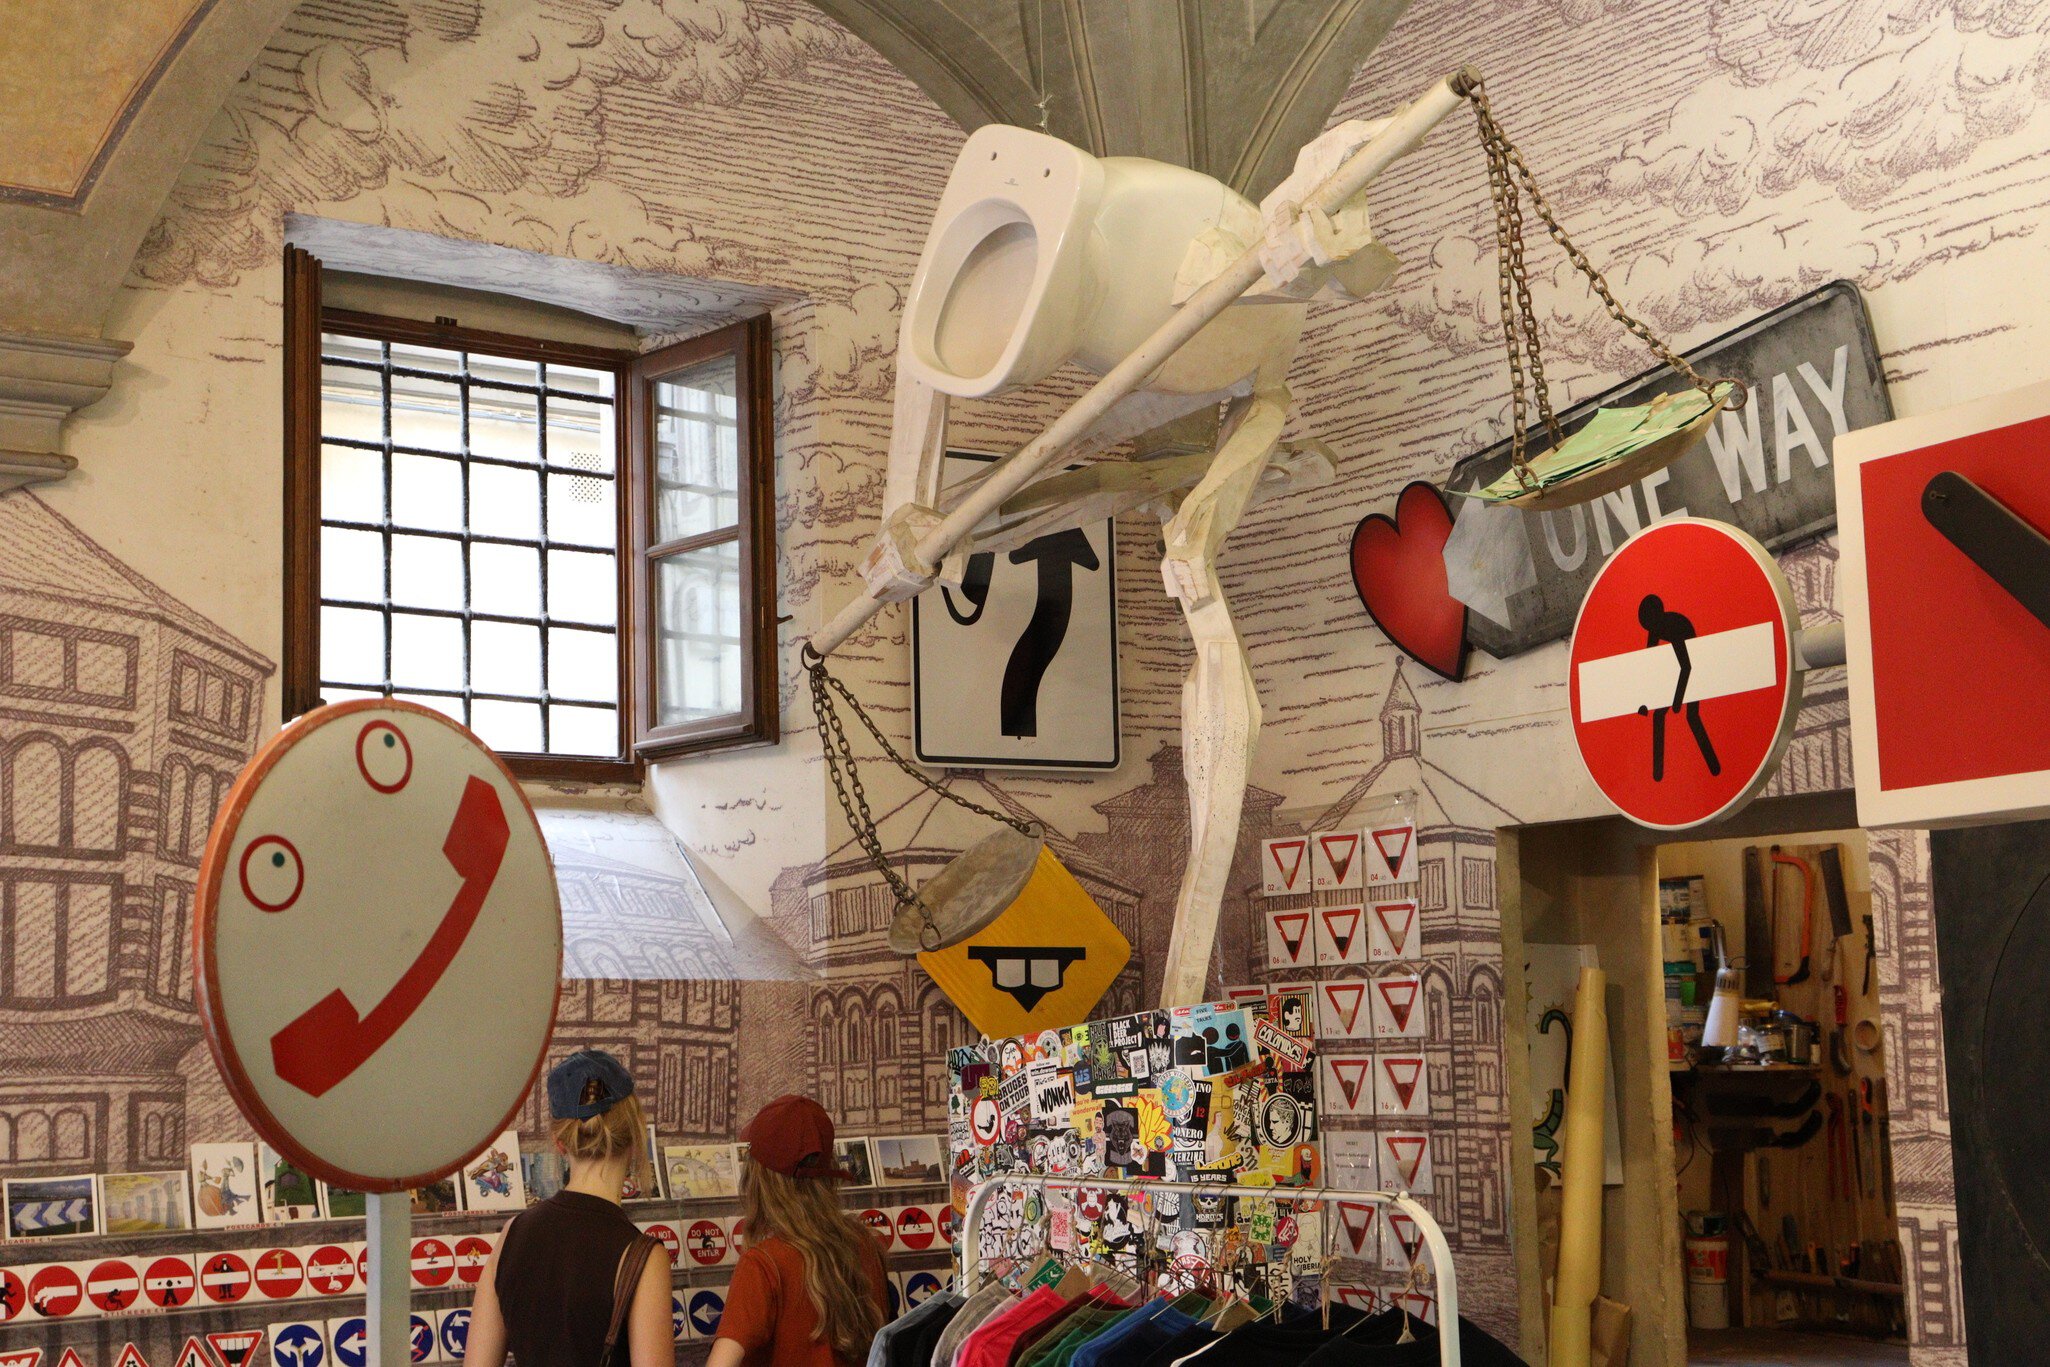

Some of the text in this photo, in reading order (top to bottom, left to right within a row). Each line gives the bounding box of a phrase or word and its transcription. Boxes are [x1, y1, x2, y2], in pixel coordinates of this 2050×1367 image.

[1704, 345, 1849, 504] WAY
[1112, 1020, 1130, 1030] BLACK
[1113, 1028, 1127, 1038] DEER
[1000, 1100, 1010, 1112] ON
[1011, 1086, 1030, 1106] TOUR
[1195, 1108, 1206, 1118] 12
[1174, 1151, 1204, 1162] TENZING
[1200, 1174, 1227, 1182] YEARS
[658, 1230, 671, 1239] NOT
[697, 1250, 720, 1258] ENTER
[1294, 1256, 1311, 1264] HOLY
